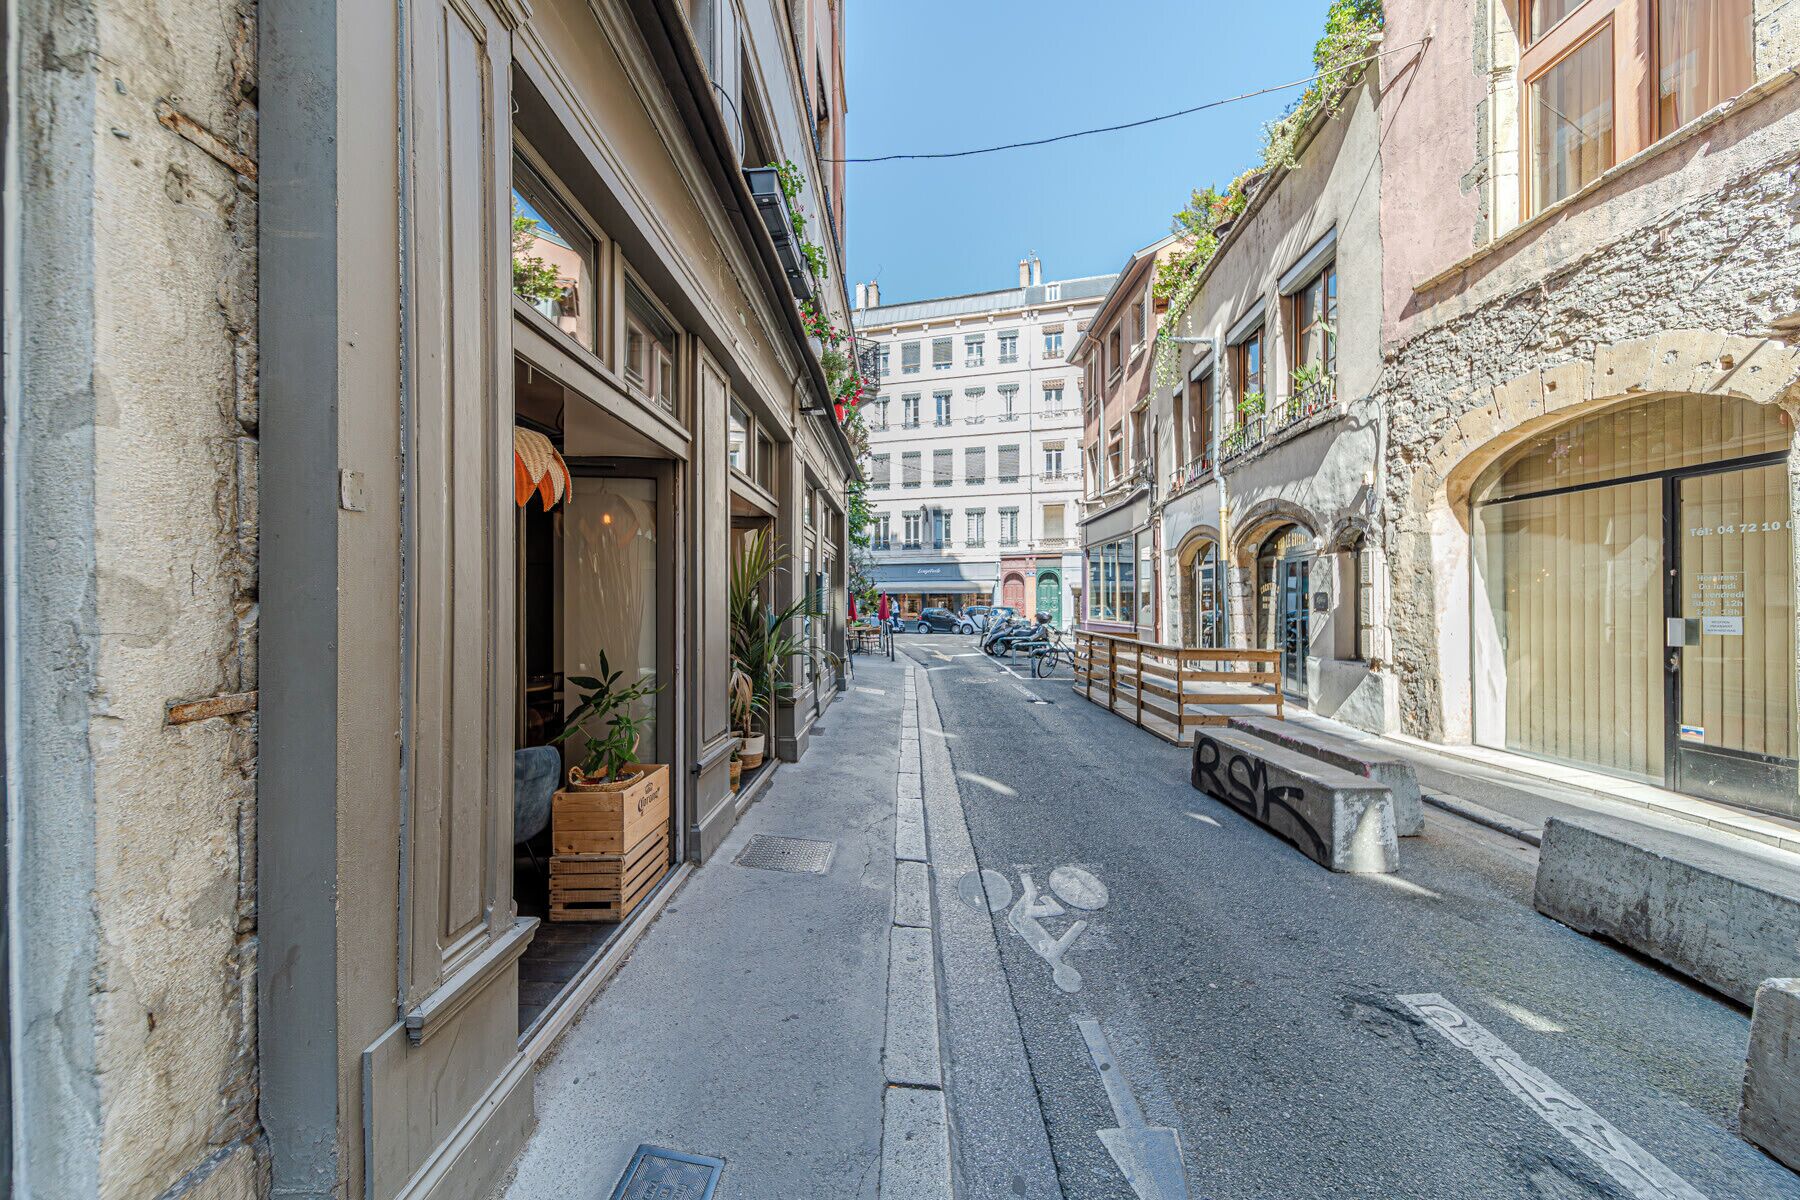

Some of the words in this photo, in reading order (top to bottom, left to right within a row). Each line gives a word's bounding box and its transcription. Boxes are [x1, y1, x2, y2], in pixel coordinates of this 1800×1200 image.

[1690, 527, 1713, 537] Tél:
[1717, 525, 1735, 535] 04
[1739, 523, 1757, 533] 72
[1762, 521, 1781, 532] 10
[1713, 582, 1736, 590] lundi
[1704, 591, 1744, 599] vendredi
